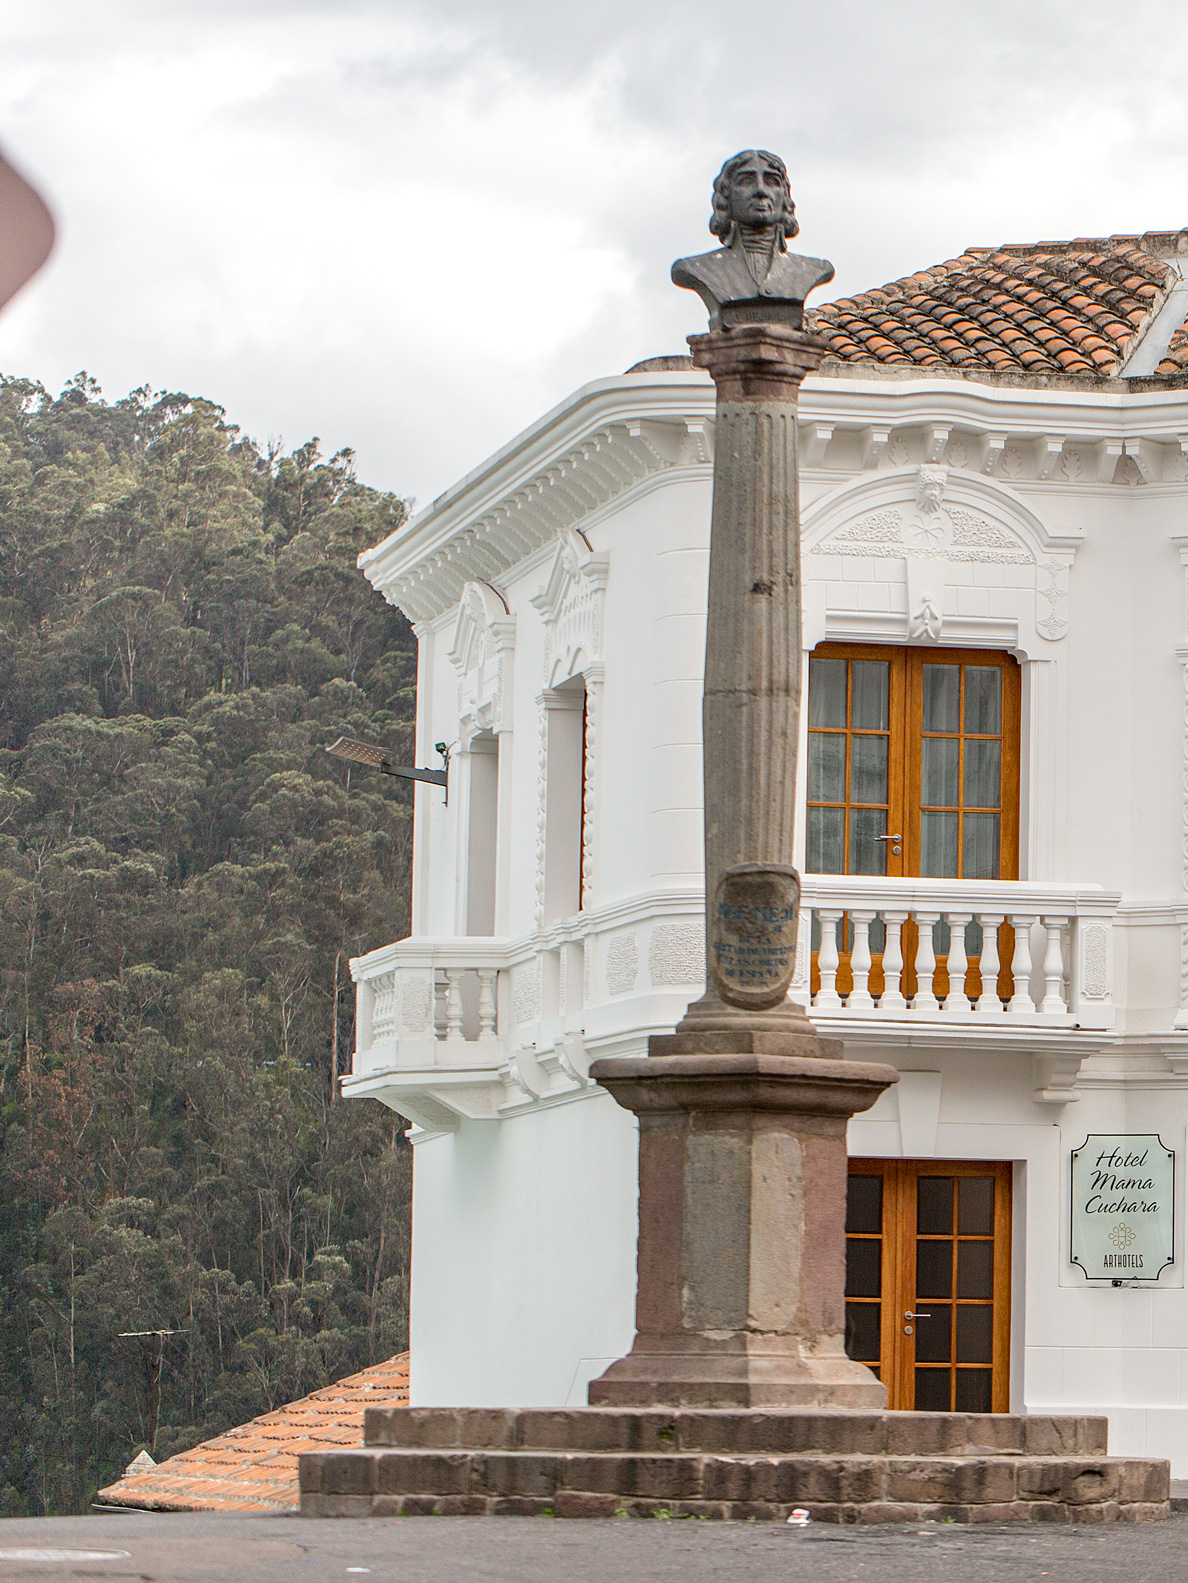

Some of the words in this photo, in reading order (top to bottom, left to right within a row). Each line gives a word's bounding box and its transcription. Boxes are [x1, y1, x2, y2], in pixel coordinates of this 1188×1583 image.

[1095, 1146, 1149, 1168] Hotel
[1090, 1170, 1156, 1191] Mama
[1085, 1195, 1160, 1214] Cuchara
[1103, 1254, 1144, 1268] ARTHOTELS
